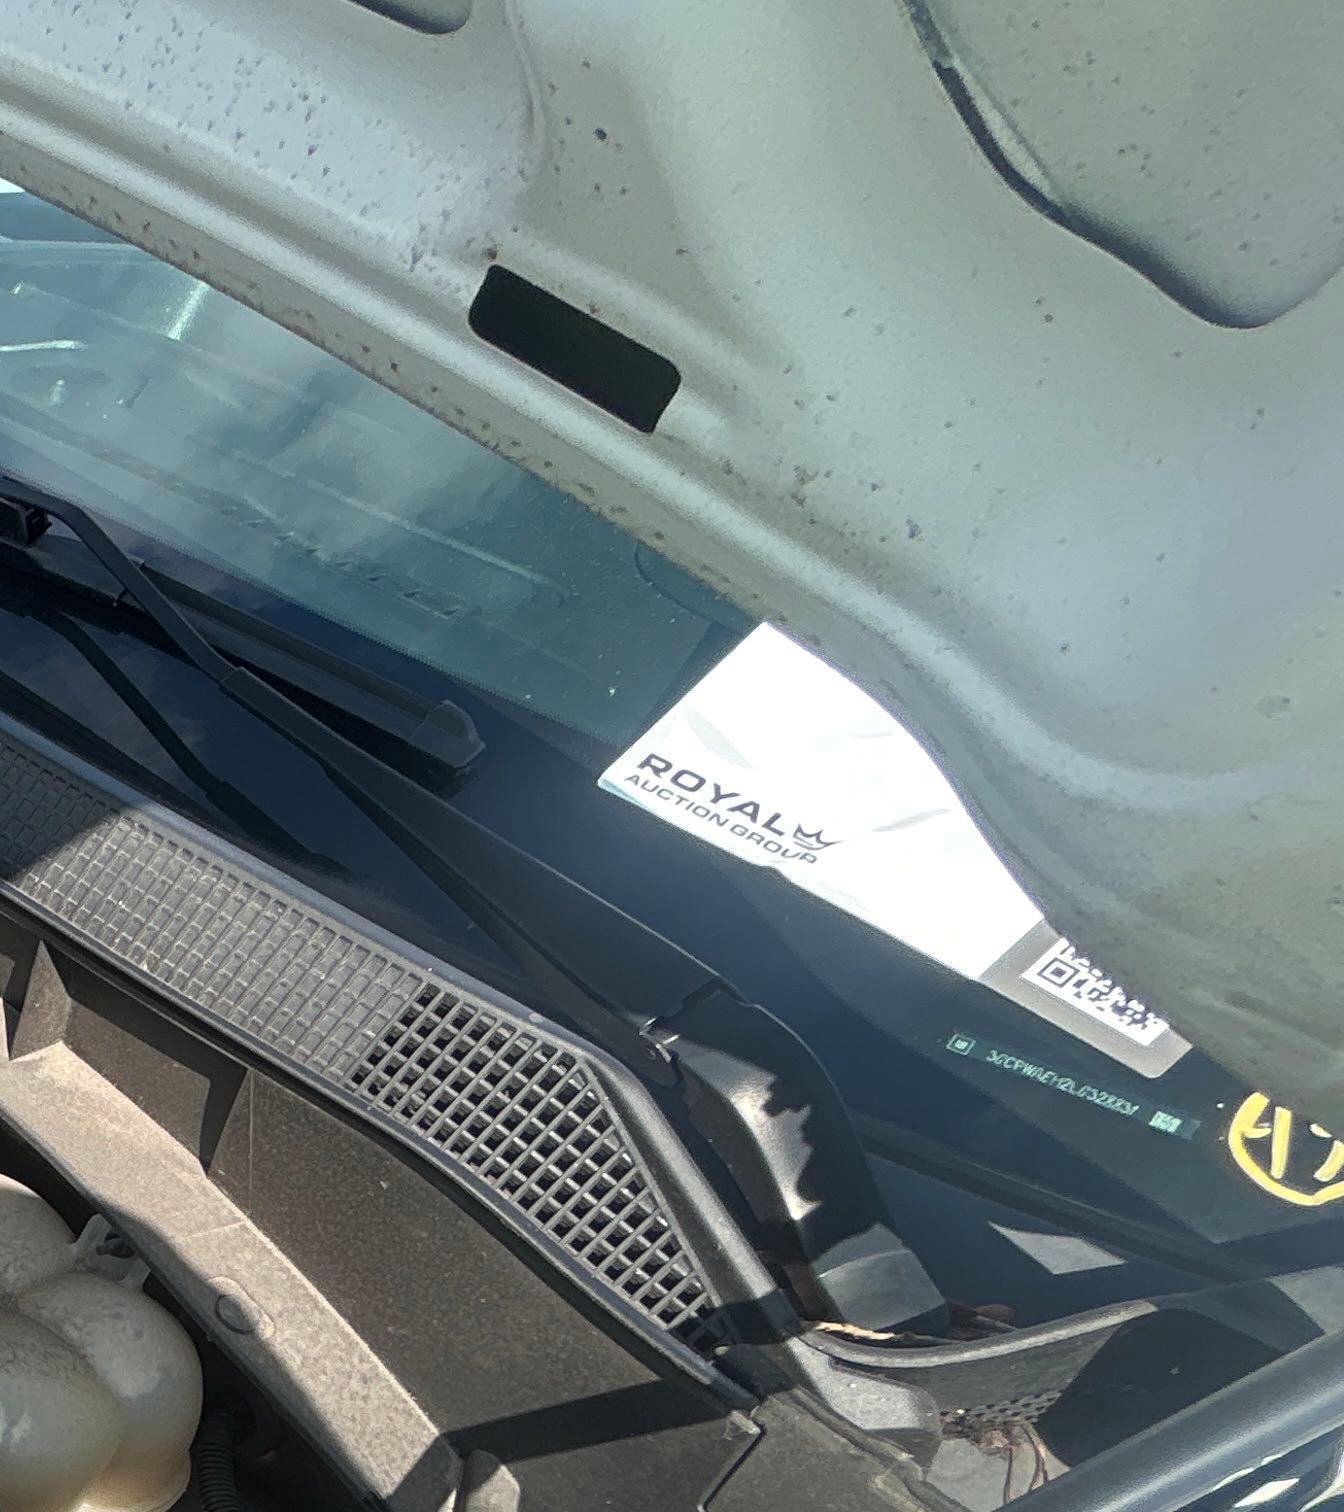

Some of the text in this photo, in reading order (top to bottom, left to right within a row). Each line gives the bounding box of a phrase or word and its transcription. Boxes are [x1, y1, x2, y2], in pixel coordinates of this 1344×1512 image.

[624, 774, 818, 865] AUCTION GROUP
[637, 753, 786, 837] ROYAL
